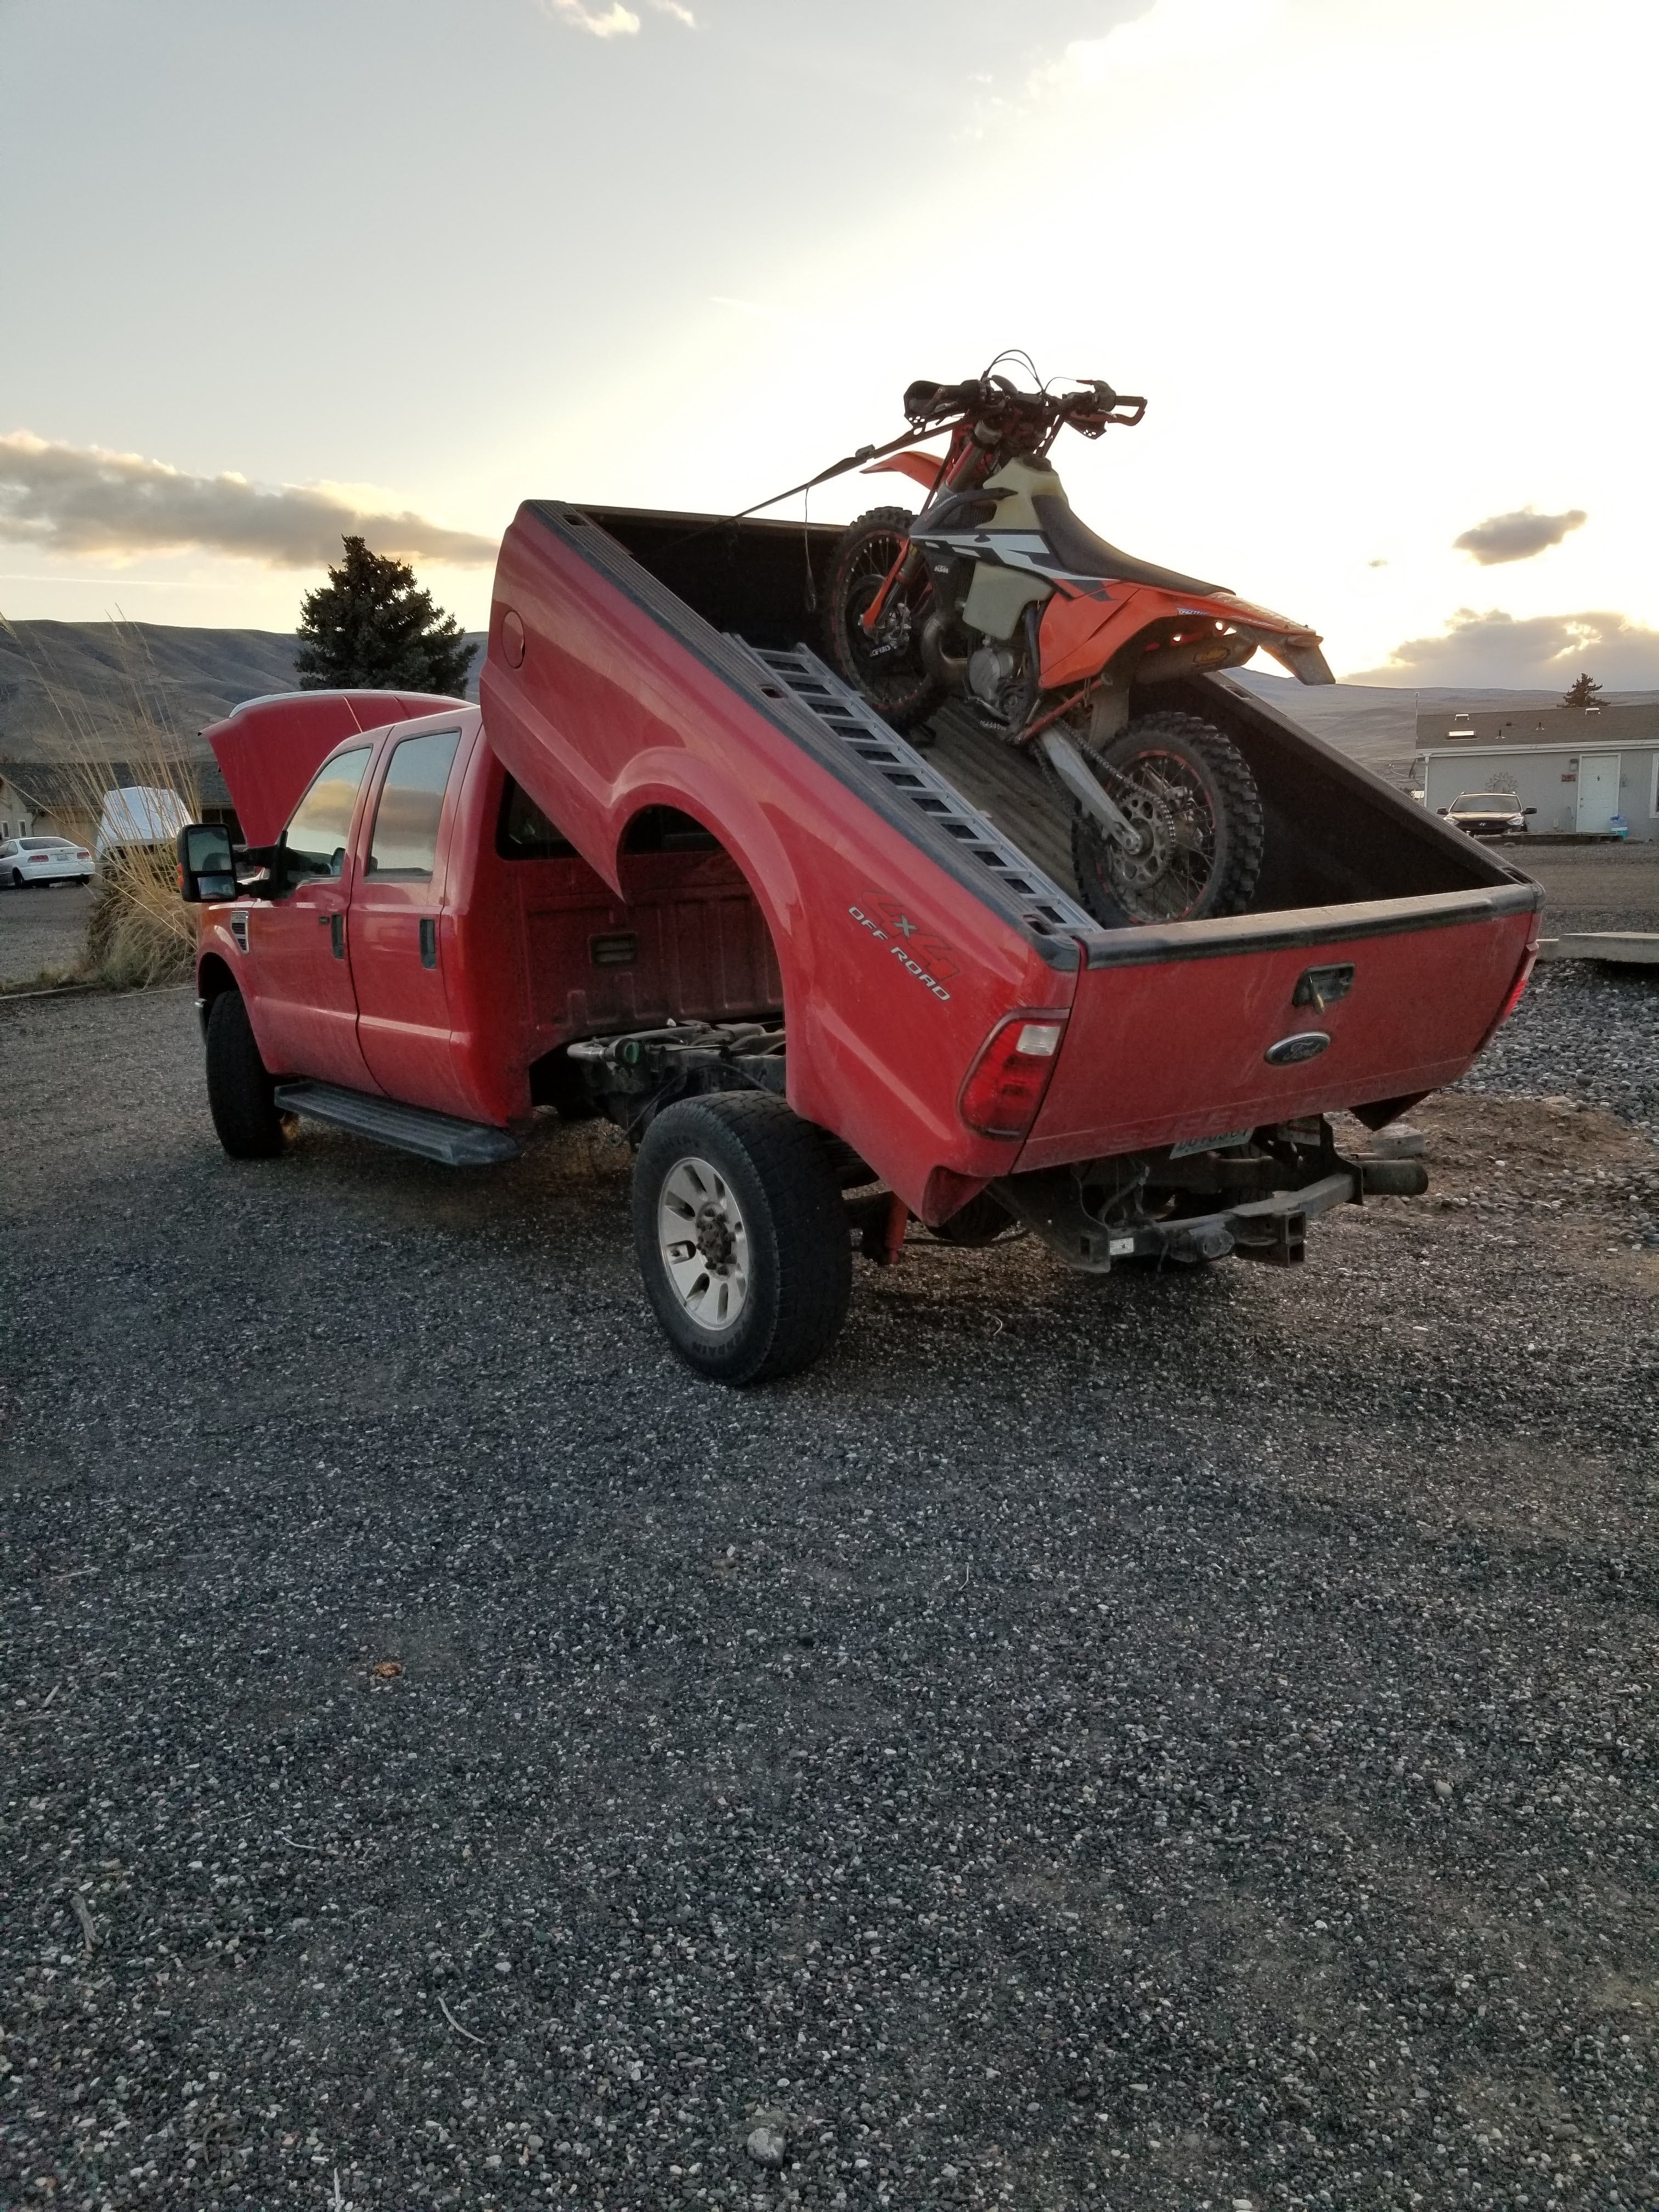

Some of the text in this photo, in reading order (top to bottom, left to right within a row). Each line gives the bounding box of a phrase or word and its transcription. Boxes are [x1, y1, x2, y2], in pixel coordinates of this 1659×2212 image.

[934, 565, 949, 574] KTM
[848, 906, 951, 1002] OFF ROAD
[1283, 1041, 1321, 1061] Ford
